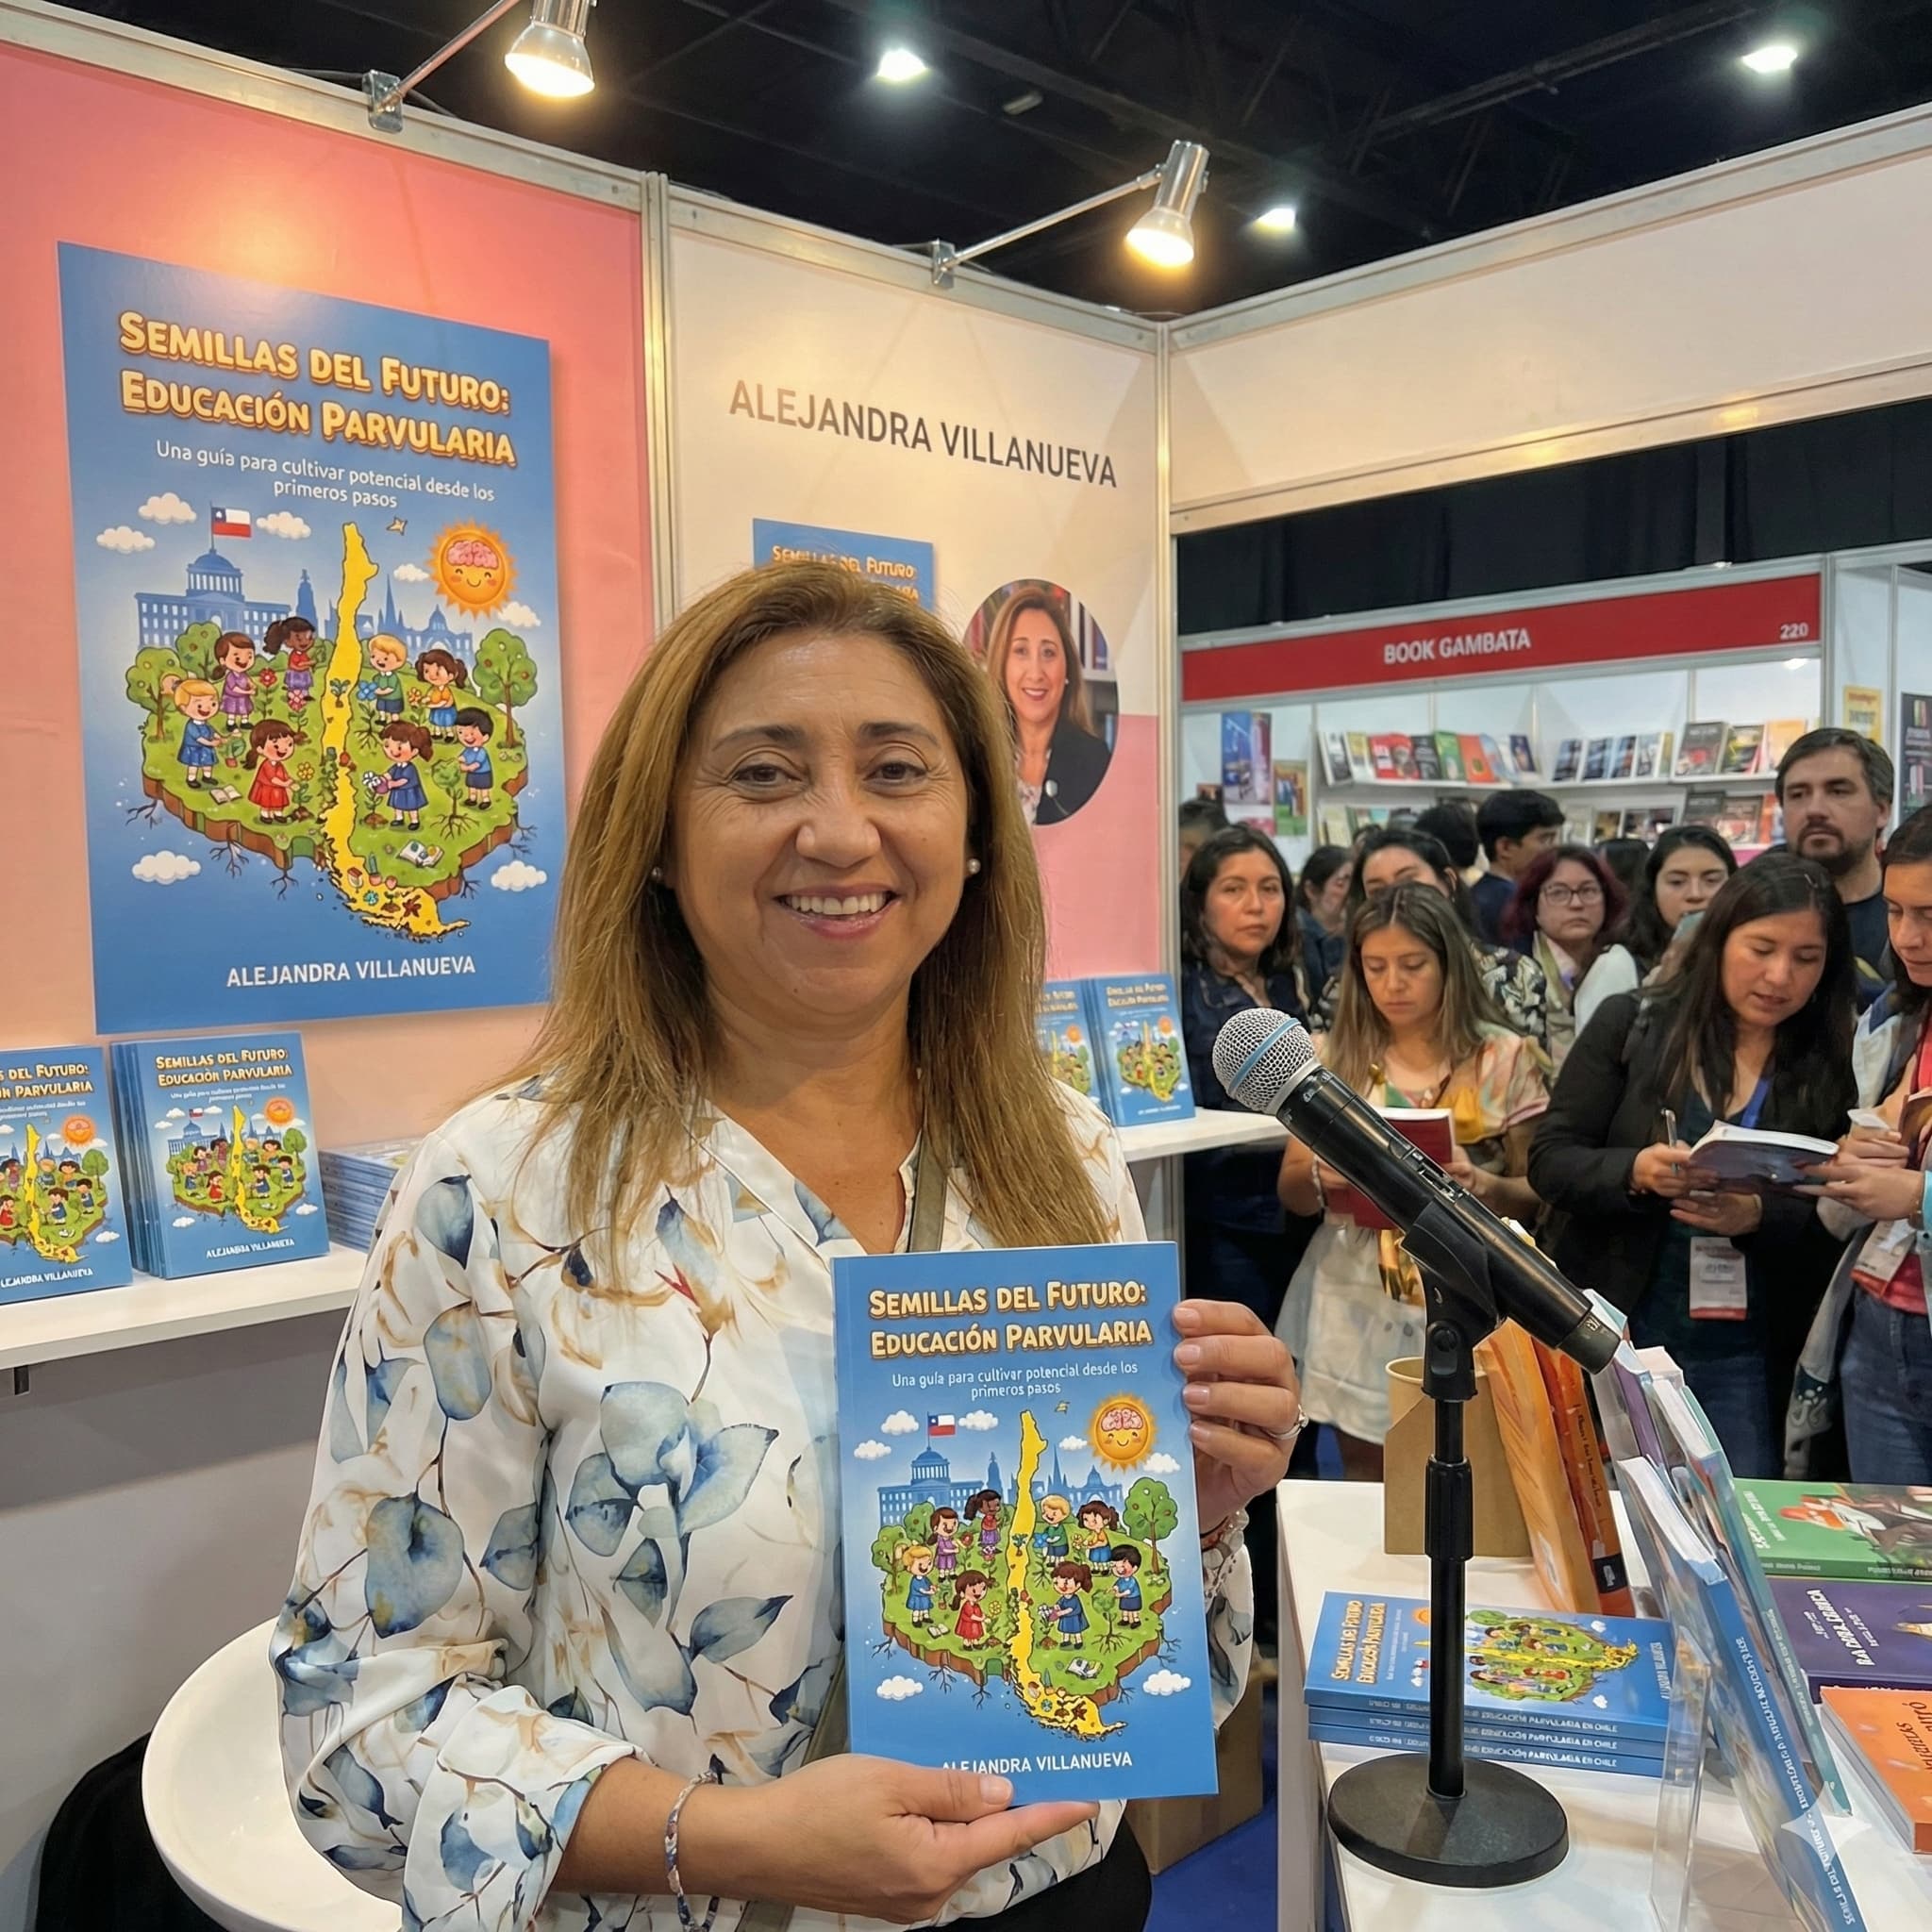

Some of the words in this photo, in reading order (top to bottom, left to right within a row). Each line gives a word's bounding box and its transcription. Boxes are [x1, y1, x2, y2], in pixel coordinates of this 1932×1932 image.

[119, 311, 298, 377] SEMILLAS
[309, 348, 371, 391] DEL
[381, 356, 512, 415] FUTURO:
[121, 370, 309, 432] EDUCACIÓN
[322, 402, 517, 467] PARVULARIA
[728, 379, 932, 452] ALEJANDRA
[941, 421, 1117, 489] VILLANUEVA
[157, 440, 192, 461] Una
[196, 445, 235, 470] guía
[240, 454, 277, 477] para
[282, 458, 344, 481] cultivar
[349, 465, 422, 492] potencial
[425, 475, 469, 498] desde
[474, 480, 495, 502] los
[274, 477, 348, 504] primeros
[352, 487, 398, 508] pasos
[1384, 639, 1436, 664] BOOK
[1439, 628, 1531, 658] GAMBATA
[1780, 623, 1809, 641] 220
[226, 963, 351, 988] ALEJANDRA
[356, 956, 476, 980] VILLANUEVA
[8, 1067, 34, 1080] DEL
[156, 1054, 215, 1071] SEMILLAS
[217, 1052, 239, 1064] DEL
[223, 1064, 293, 1082] PARVULARIA
[14, 1080, 94, 1098] PARVULARIA
[869, 1288, 988, 1319] SEMILLAS
[996, 1285, 1041, 1312] DEL
[1046, 1279, 1147, 1311] FUTURO:
[871, 1323, 999, 1359] EDUCACIÓN
[1005, 1319, 1155, 1352] PARVULARIA
[892, 1373, 916, 1388] Una
[919, 1369, 945, 1390] guía
[948, 1371, 974, 1389] para
[977, 1366, 1024, 1384] cultivar
[1025, 1362, 1080, 1384] potencial
[1082, 1361, 1119, 1377] desde
[1121, 1359, 1139, 1374] los
[971, 1383, 1025, 1403] primeros
[1027, 1381, 1061, 1400] pasos
[1037, 1751, 1133, 1773] VILLANUEVA
